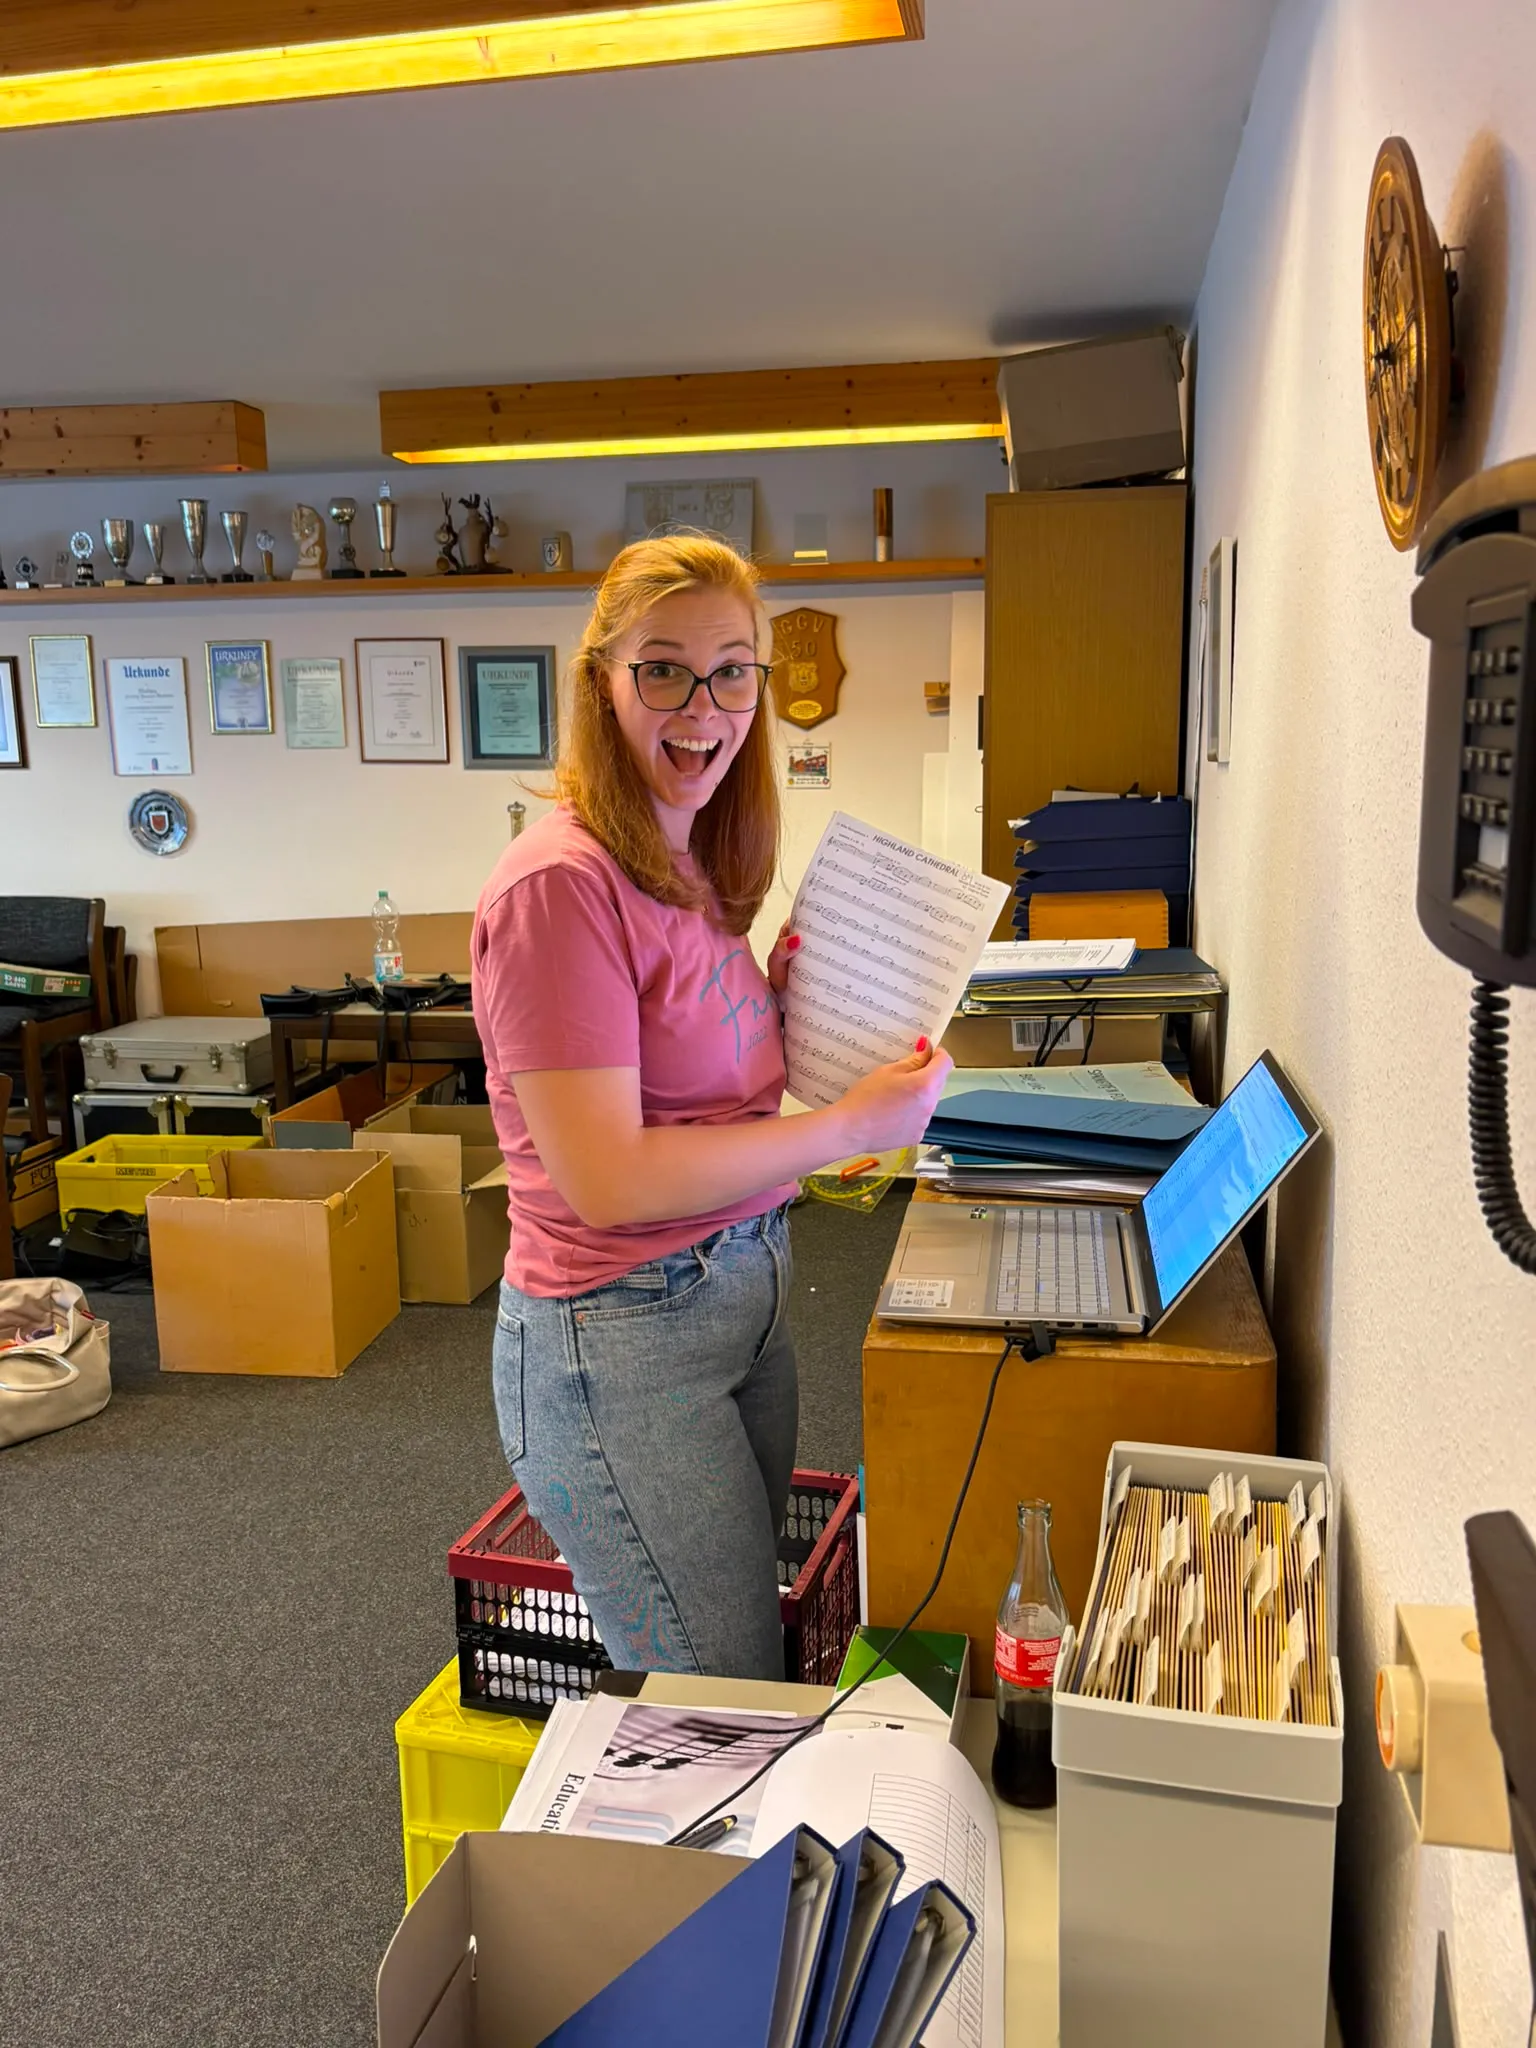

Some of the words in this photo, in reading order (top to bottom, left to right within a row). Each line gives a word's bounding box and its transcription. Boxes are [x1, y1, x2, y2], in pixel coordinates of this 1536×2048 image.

[791, 641, 817, 657] 50
[123, 665, 170, 679] Urkunde
[872, 834, 915, 857] HIGHLAND
[914, 852, 960, 877] CATHEDRAL
[115, 1168, 156, 1176] METRO
